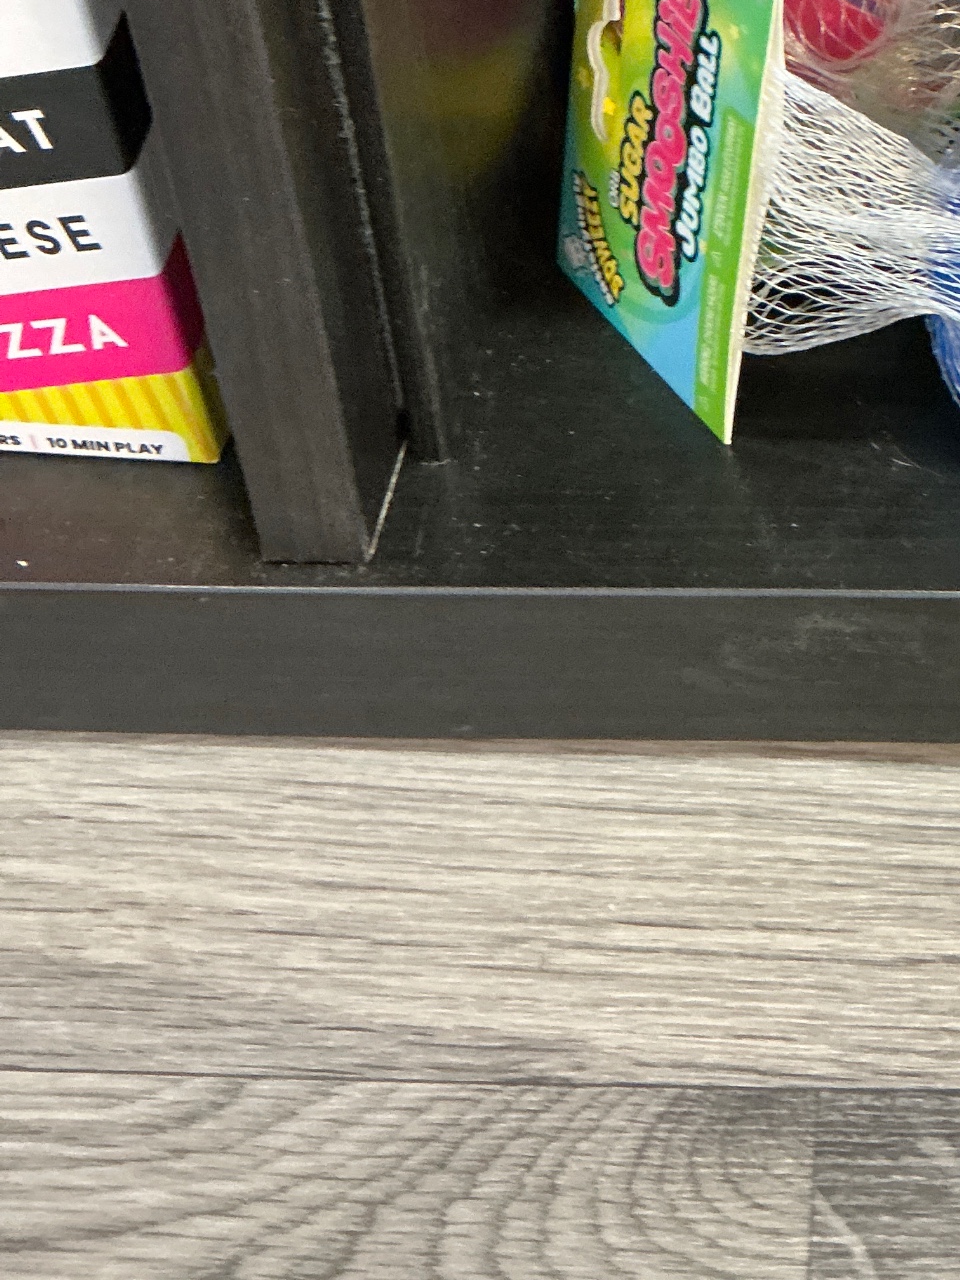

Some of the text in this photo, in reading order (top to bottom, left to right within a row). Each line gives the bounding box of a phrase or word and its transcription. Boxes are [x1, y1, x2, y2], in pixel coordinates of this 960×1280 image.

[620, 94, 654, 226] SUGAR
[675, 33, 720, 259] JUMBO BALL
[46, 436, 68, 449] 10
[72, 438, 111, 453] MIN
[113, 441, 163, 456] PLAY
